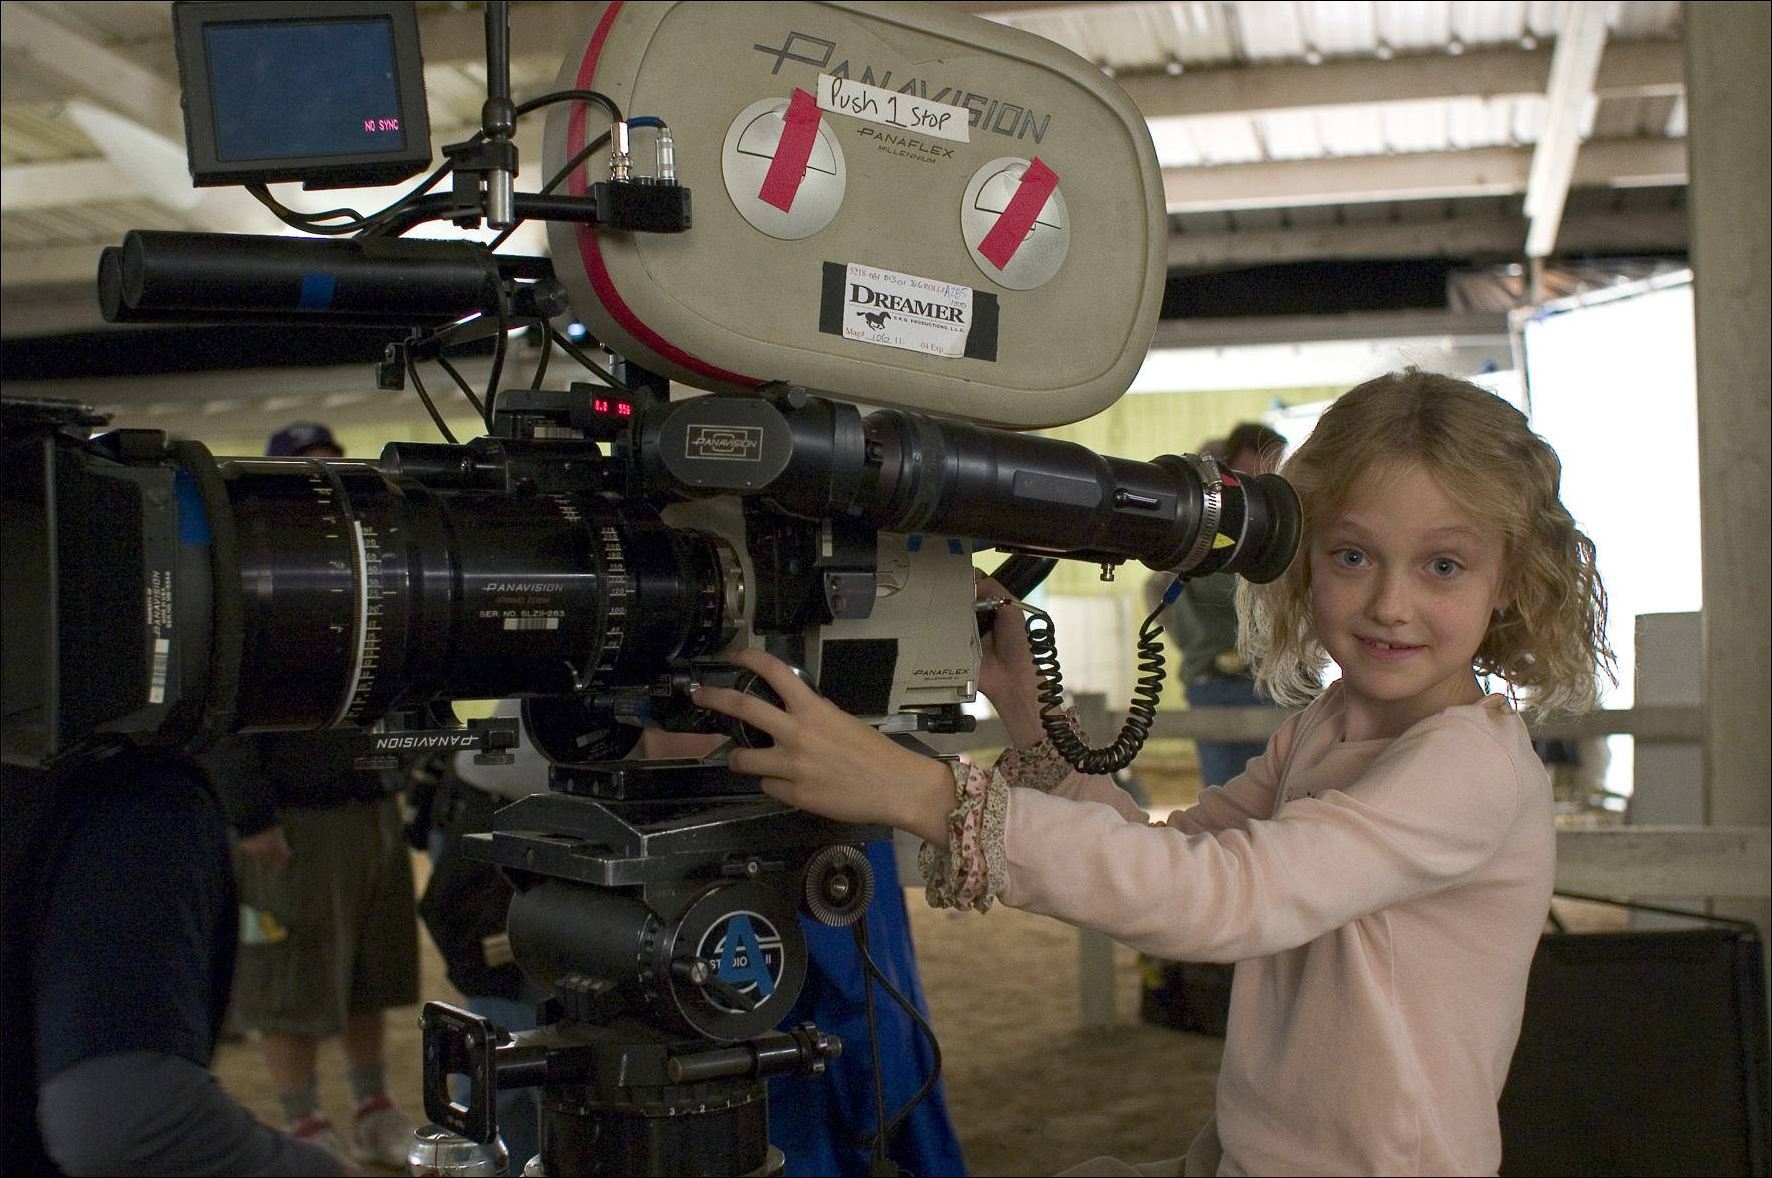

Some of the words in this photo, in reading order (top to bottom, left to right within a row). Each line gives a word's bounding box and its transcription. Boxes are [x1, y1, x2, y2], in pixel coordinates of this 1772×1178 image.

[831, 77, 879, 114] Push
[886, 97, 908, 128] 1
[364, 120, 376, 131] NO
[379, 119, 399, 131] SYNC
[857, 127, 955, 160] PANAFLEX
[878, 145, 937, 165] MILLENNIUM
[849, 283, 966, 324] DREAMER
[691, 437, 758, 449] PANAVISION
[482, 583, 564, 592] PANAVISION
[912, 668, 970, 676] PANAFLEX
[376, 735, 479, 749] PANAVISION
[710, 955, 748, 971] STIO
[712, 914, 778, 1003] A
